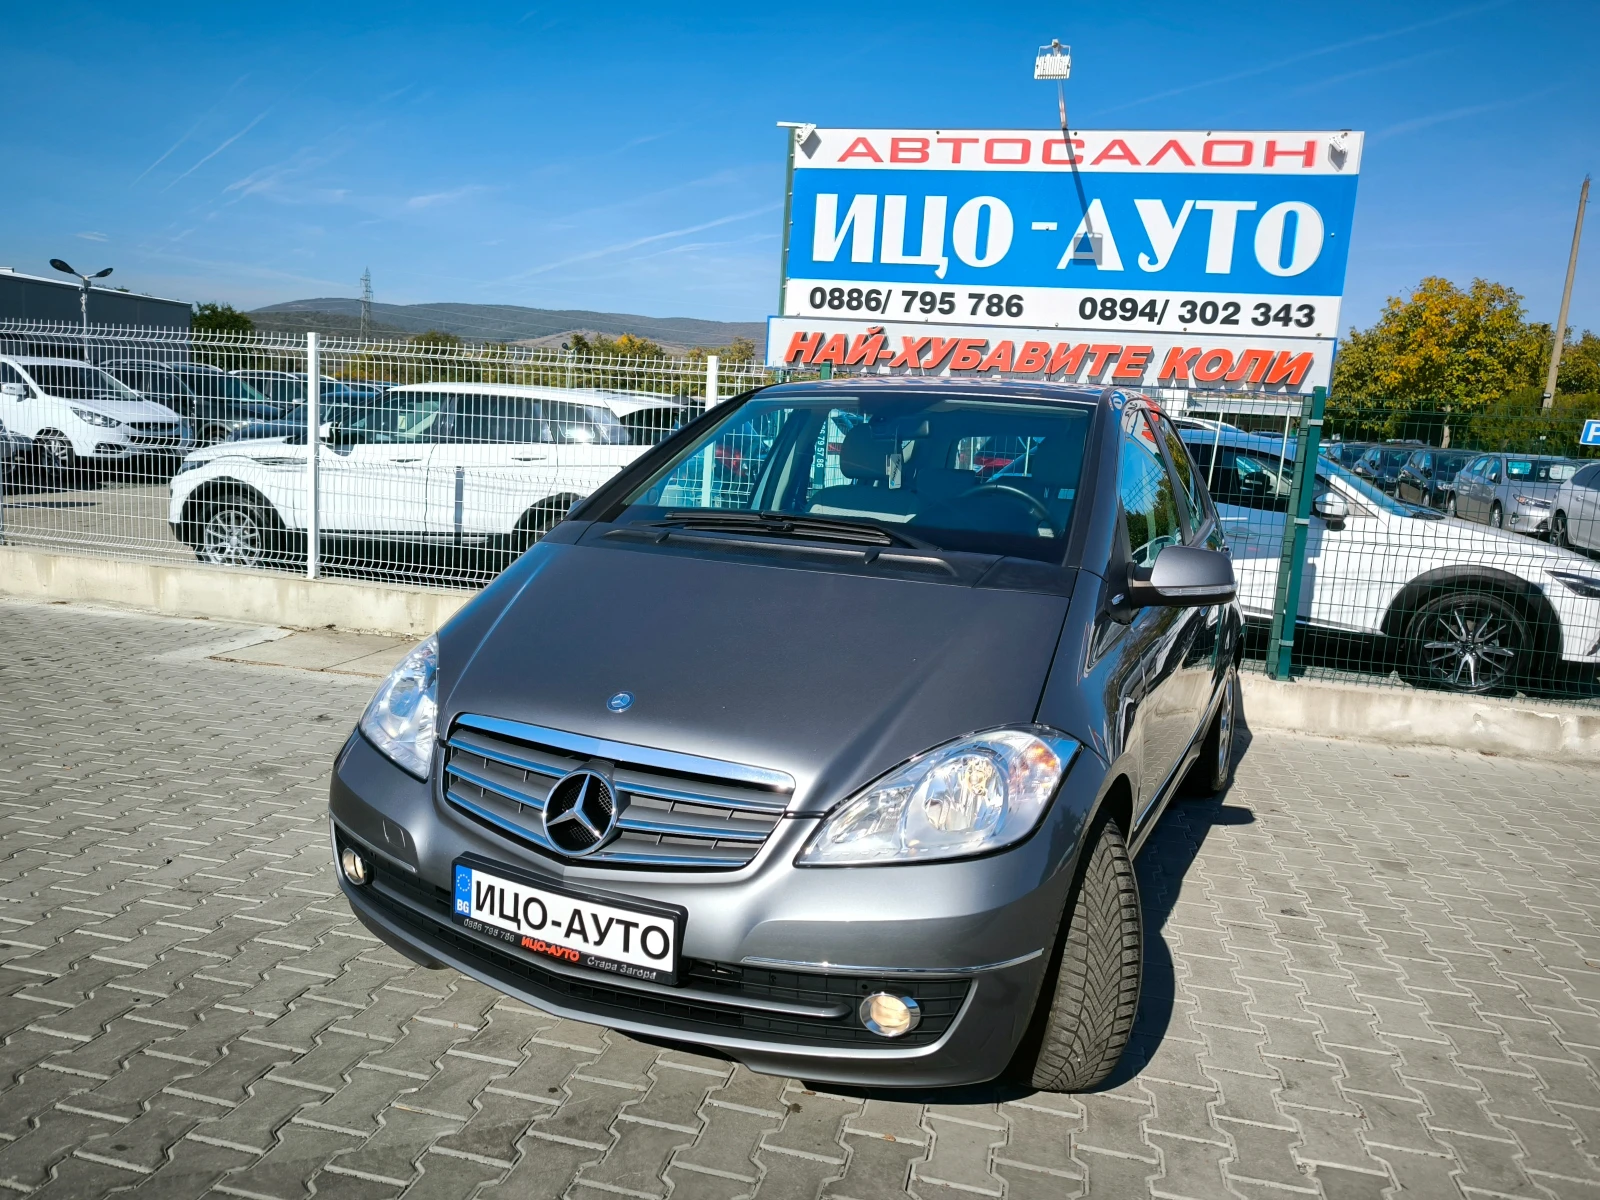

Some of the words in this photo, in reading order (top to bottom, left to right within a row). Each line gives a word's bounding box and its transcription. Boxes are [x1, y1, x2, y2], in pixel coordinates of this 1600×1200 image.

[837, 137, 1317, 168] АВТОСАЛОН
[809, 286, 892, 314] 0886/
[901, 291, 956, 315] 795
[967, 292, 1024, 318] 786
[1078, 297, 1169, 326] 0894/
[1179, 301, 1241, 326] 302
[1251, 303, 1316, 328] 343
[783, 325, 1153, 380] НАЙ-ХУБАВИТЕ
[1157, 346, 1315, 386] КОЛИ
[456, 898, 470, 914] BG
[475, 880, 670, 960] ИЦО-АУТО
[521, 936, 580, 962] ИЦО-АУТО
[587, 956, 617, 972] Стара
[620, 964, 657, 980] Загора
